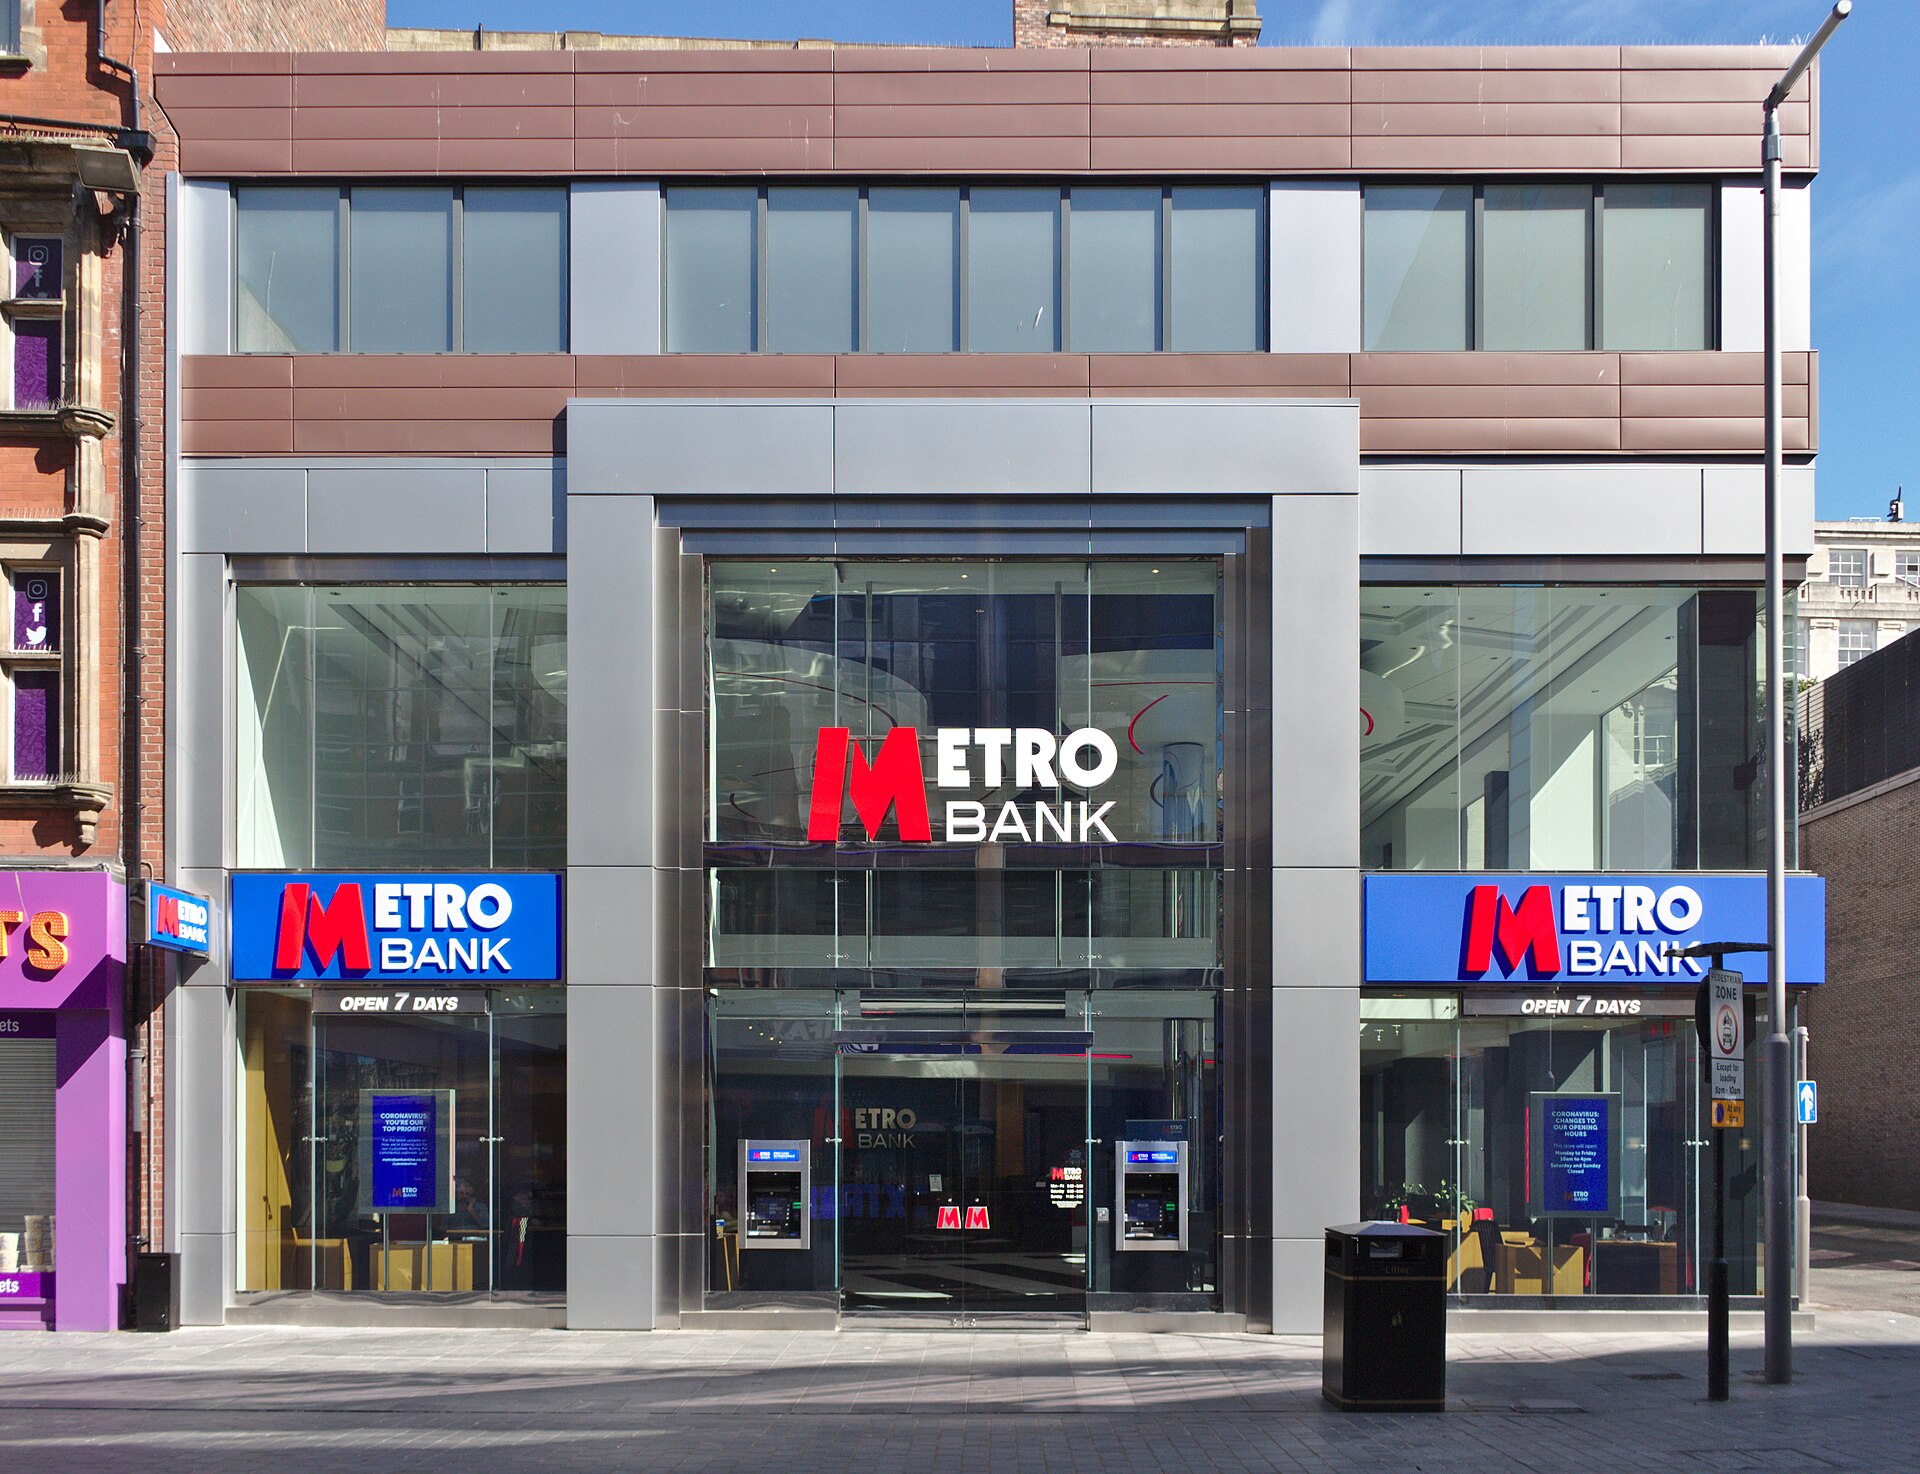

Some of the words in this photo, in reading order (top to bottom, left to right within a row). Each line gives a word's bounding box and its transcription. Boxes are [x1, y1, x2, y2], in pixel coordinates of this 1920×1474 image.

[807, 727, 1118, 843] METRO
[945, 801, 1118, 843] BANK
[157, 895, 208, 937] METRO
[276, 883, 513, 969] METRO
[179, 923, 208, 944] BANK
[1466, 885, 1703, 972] METRO
[381, 938, 513, 970] BANK
[1570, 940, 1703, 973] BANK
[1711, 972, 1742, 984] PEDESTRIAN
[340, 997, 389, 1011] OPEN
[394, 992, 410, 1011] 7
[413, 997, 459, 1011] DAYS
[1715, 985, 1737, 1001] ZONE
[1521, 999, 1570, 1014] OPEN
[1576, 994, 1591, 1014] 7
[1595, 999, 1641, 1014] DAYS
[1716, 1062, 1732, 1072] Except
[1720, 1073, 1737, 1084] loading
[858, 1133, 917, 1149] BANK
